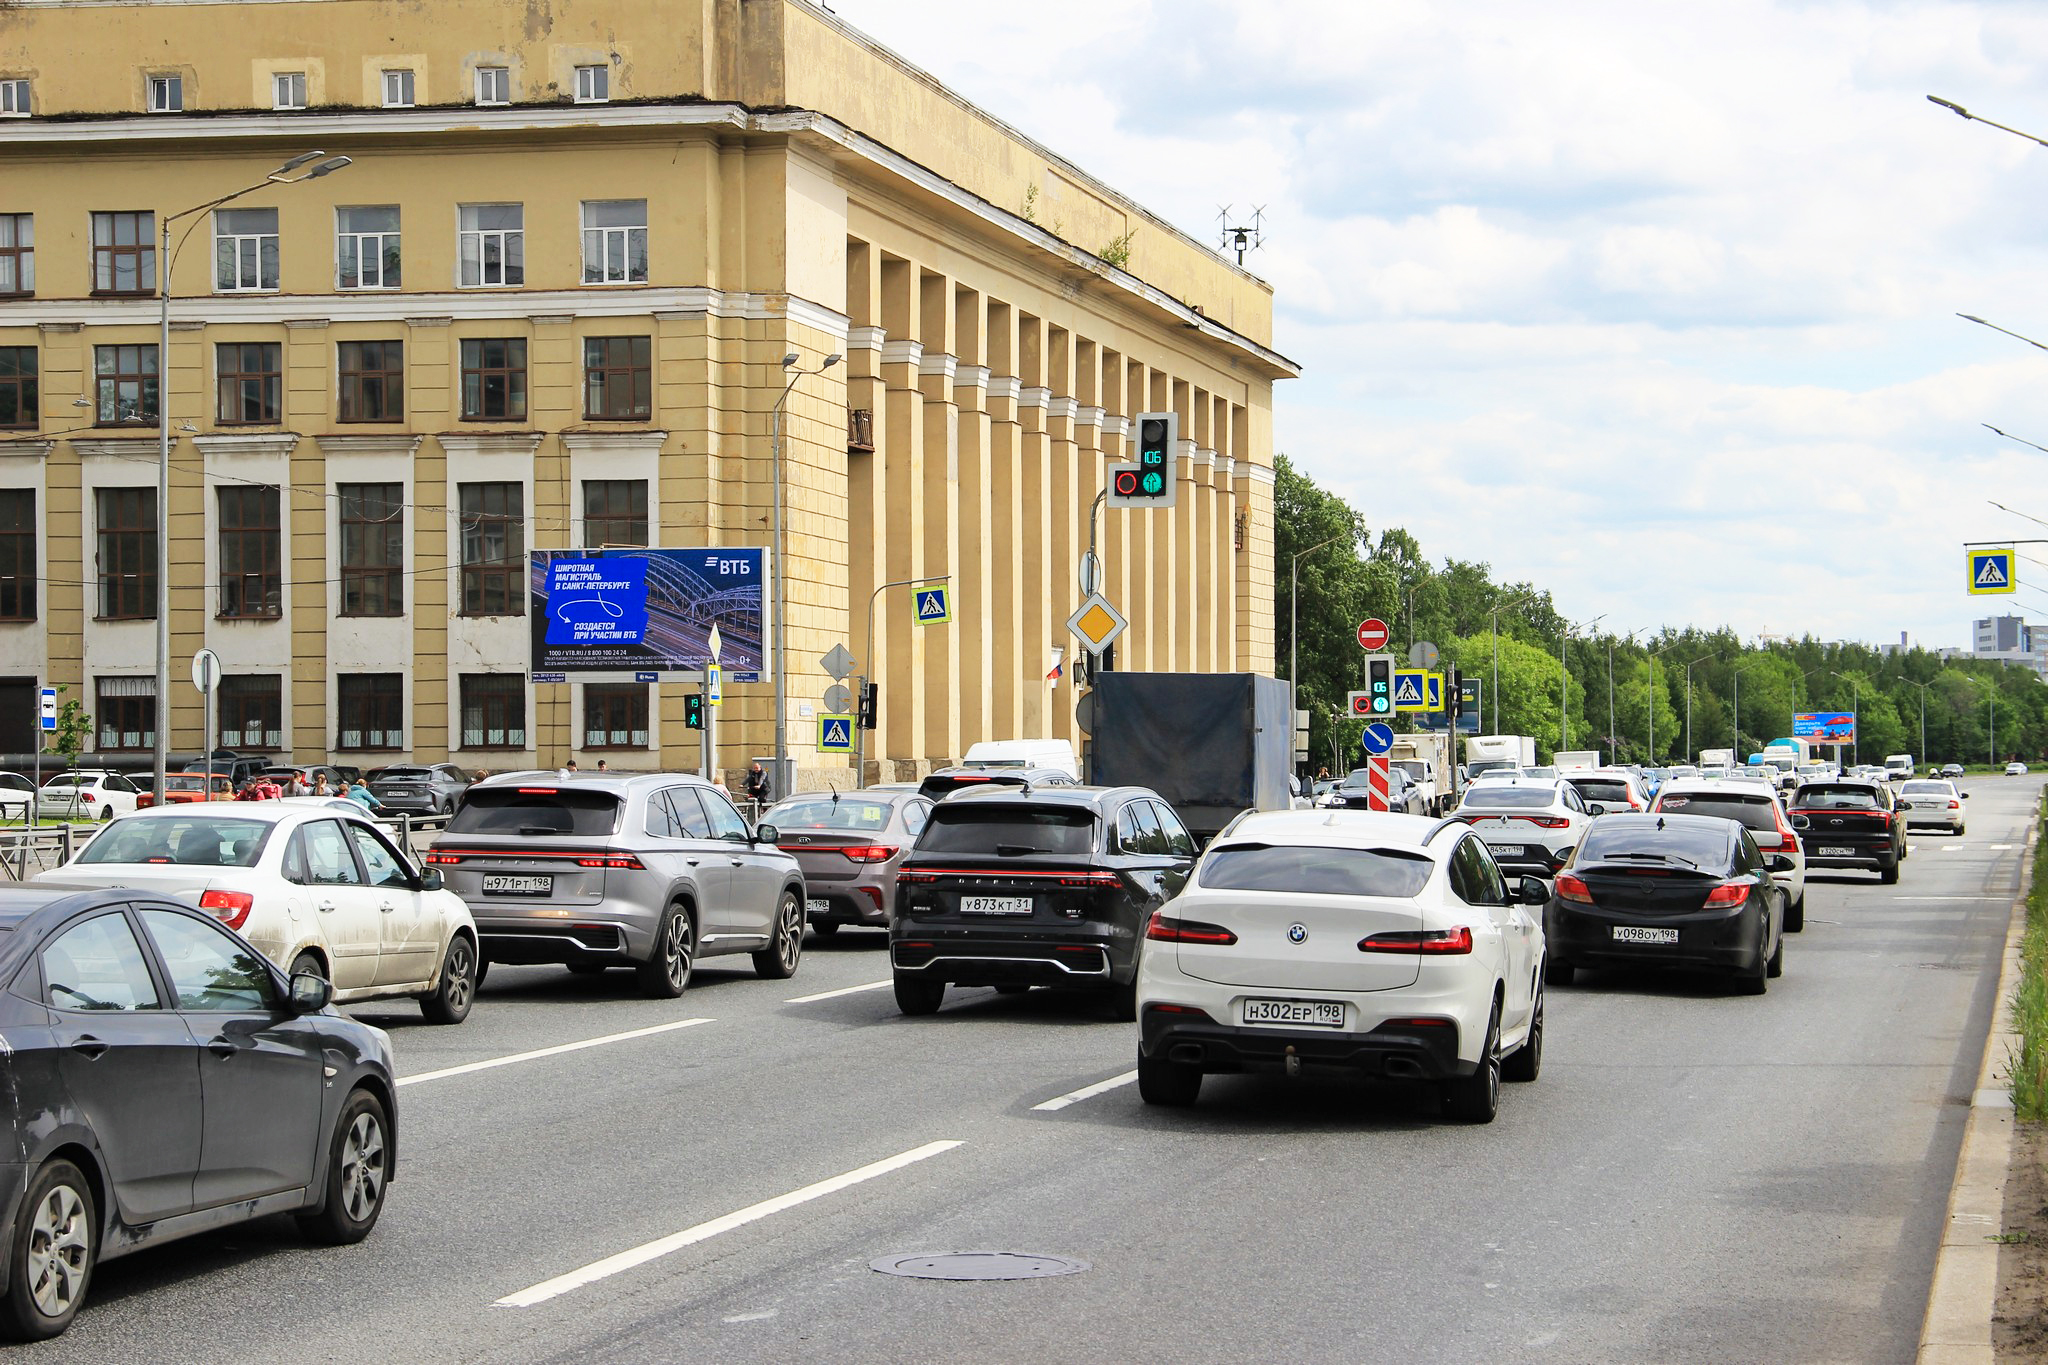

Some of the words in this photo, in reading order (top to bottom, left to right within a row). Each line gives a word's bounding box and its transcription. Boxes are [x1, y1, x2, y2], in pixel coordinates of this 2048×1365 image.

[1144, 451, 1162, 464] 106
[555, 564, 595, 572] ШИРОТНАЯ
[720, 560, 750, 574] ВТБ
[555, 573, 602, 581] МАГИСТРАЛЬ
[562, 581, 630, 590] САНКТ-ПЕТЕРБУРГЕ
[574, 622, 615, 631] СОЗДАЕТСЯ
[574, 631, 589, 640] ПРИ
[590, 631, 622, 639] УЧАСТИИ
[623, 631, 637, 639] ВТБ
[739, 655, 751, 664] 0+
[486, 878, 529, 889] Н971РТ
[532, 878, 549, 886] 198
[966, 898, 1012, 911] У873КТ
[1016, 898, 1028, 908] 31
[1617, 928, 1658, 940] У098ОУ
[1660, 929, 1676, 938] 198
[1249, 1003, 1312, 1020] Н302ЕР
[1316, 1004, 1340, 1017] 198
